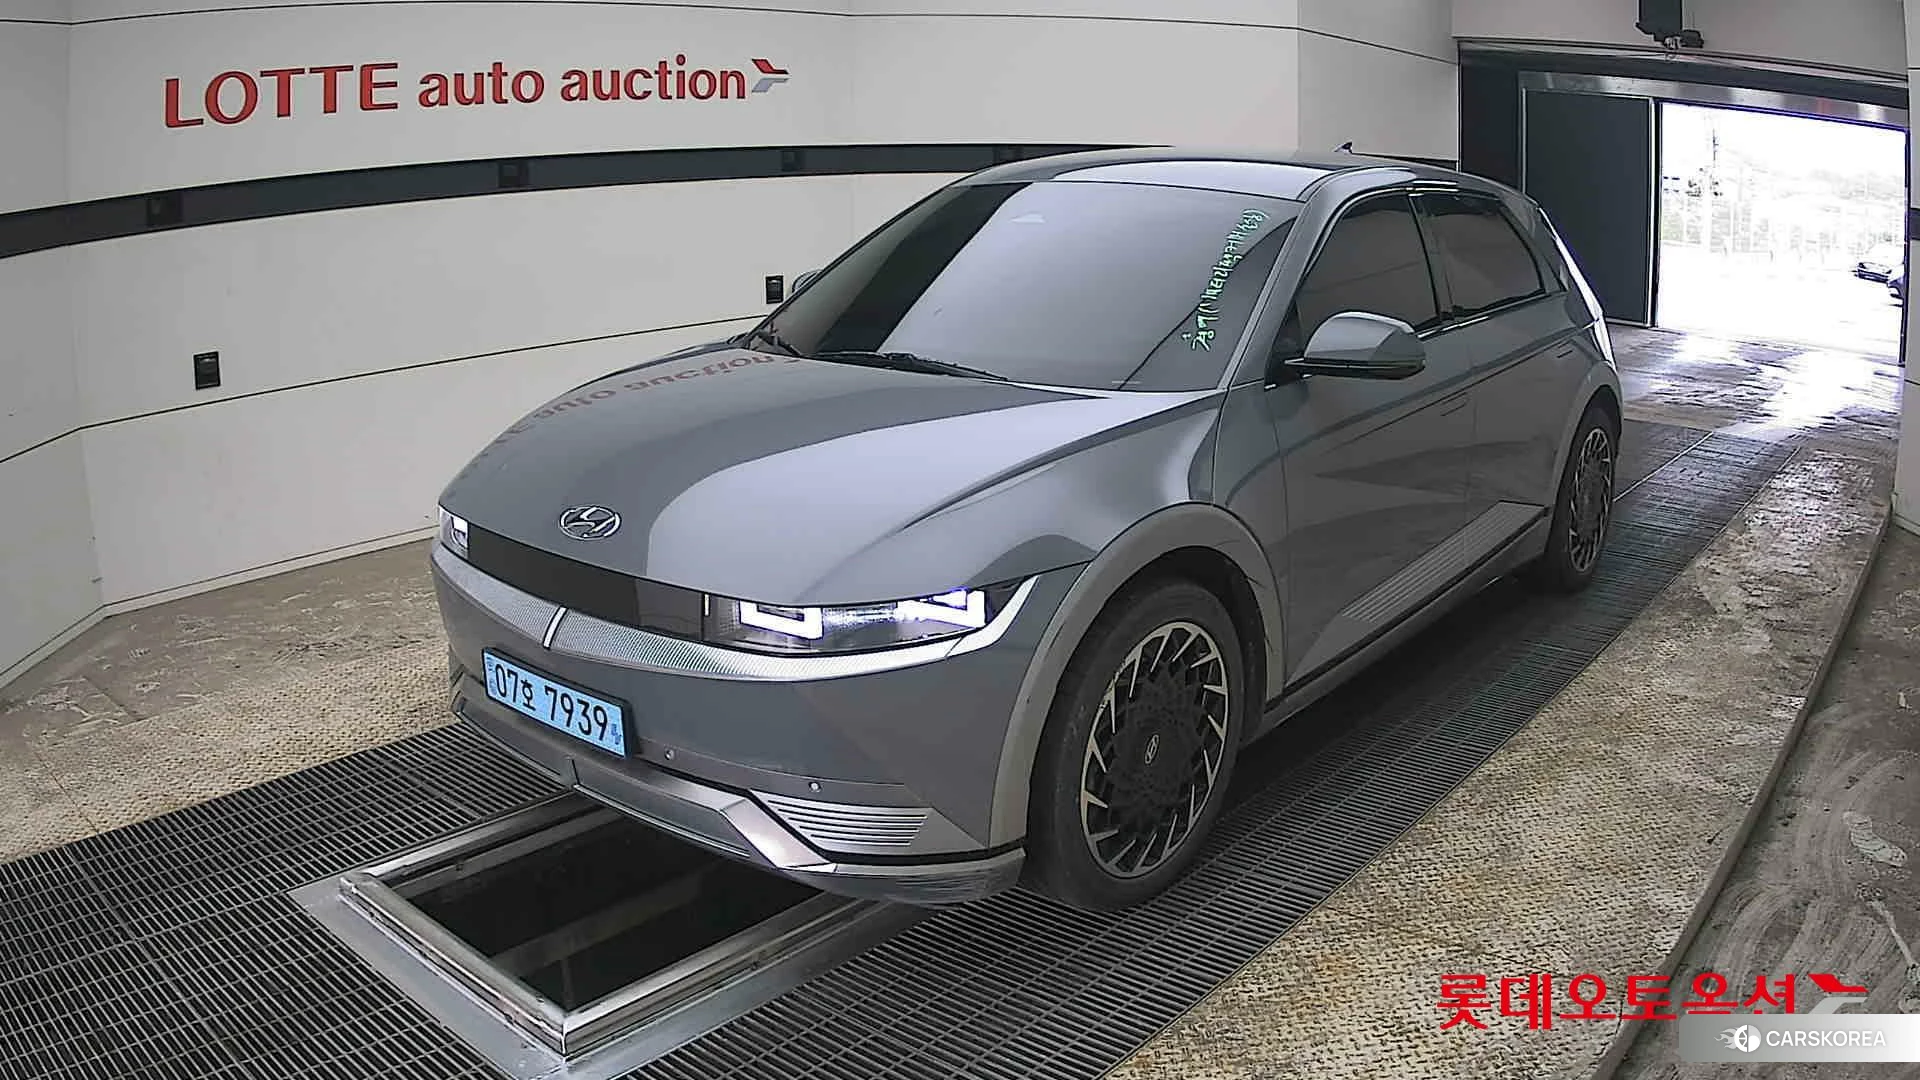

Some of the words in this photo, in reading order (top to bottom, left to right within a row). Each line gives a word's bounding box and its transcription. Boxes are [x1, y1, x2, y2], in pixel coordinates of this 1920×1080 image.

[165, 62, 398, 128] LOTTE
[418, 61, 545, 107] auto
[560, 54, 746, 101] auction
[495, 663, 536, 711] 07호
[544, 684, 608, 741] 7939
